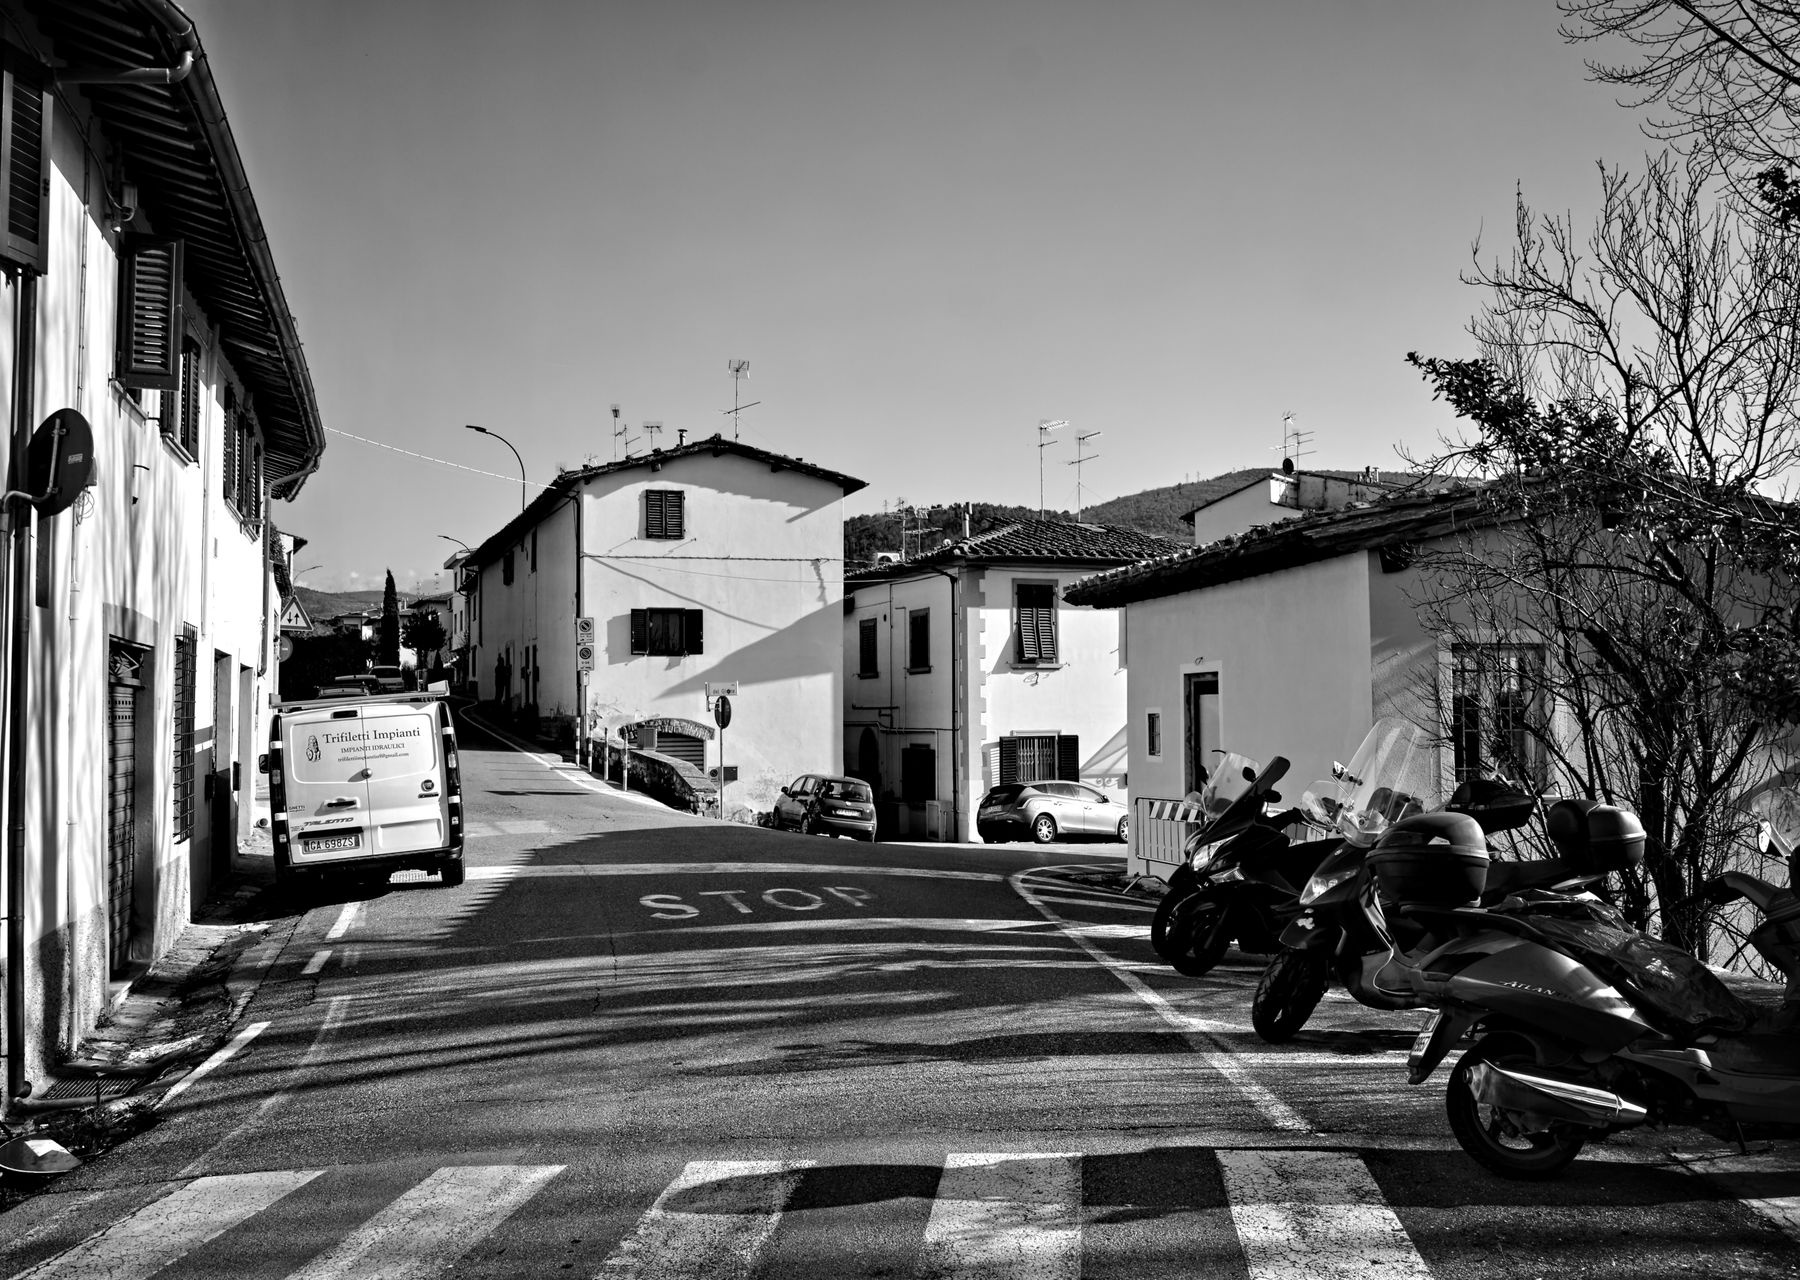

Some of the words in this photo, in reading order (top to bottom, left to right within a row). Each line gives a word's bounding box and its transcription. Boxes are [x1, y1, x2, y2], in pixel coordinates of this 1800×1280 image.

[323, 731, 370, 744] Trifiletti
[374, 728, 421, 740] Impianti
[639, 886, 876, 920] STOP
